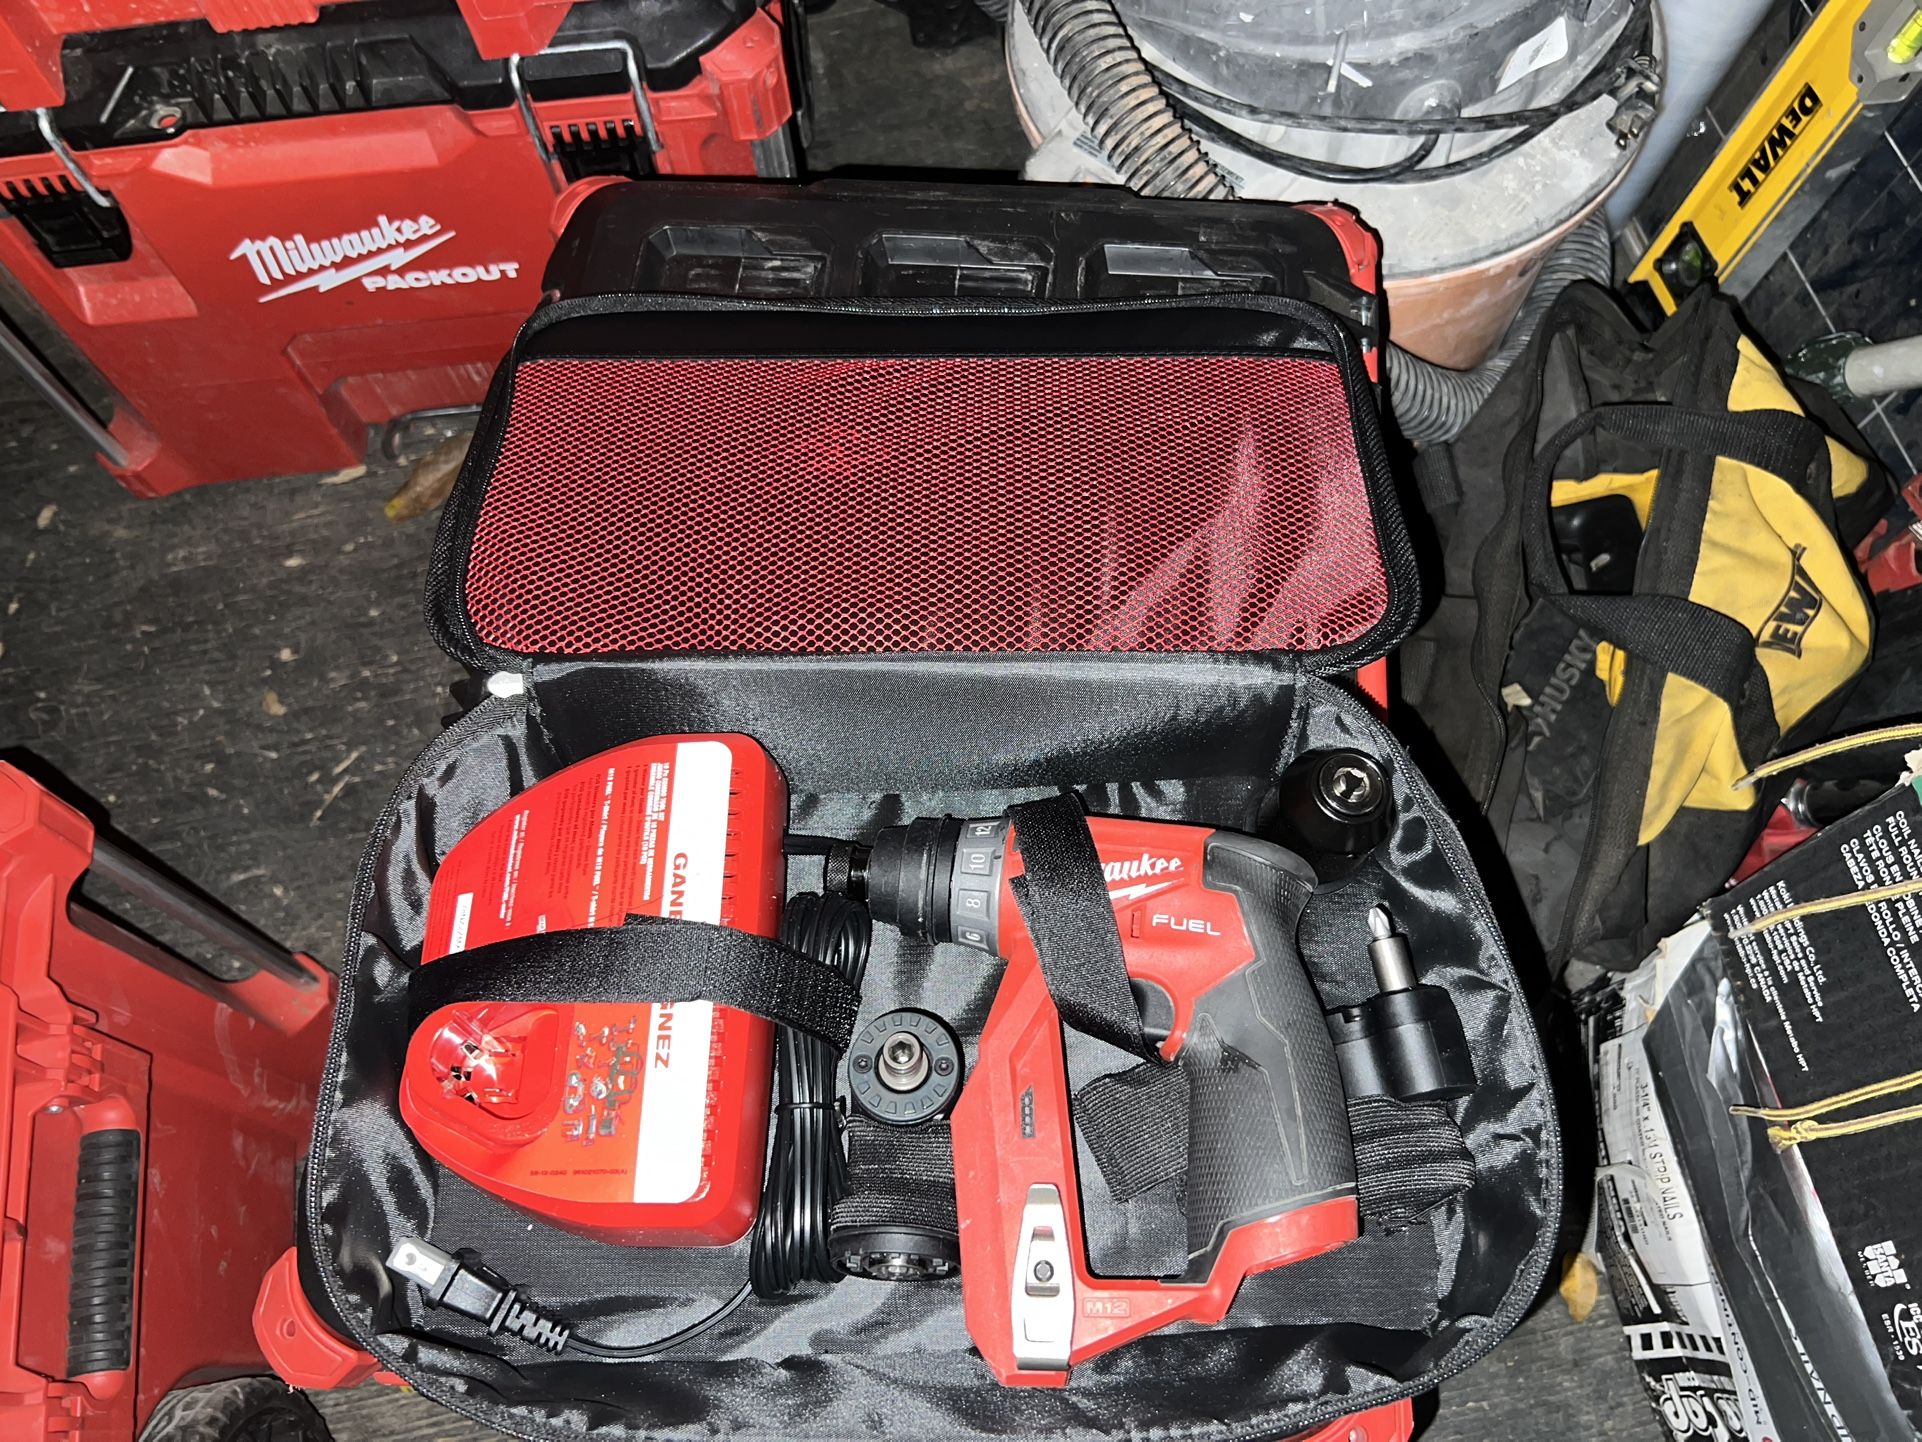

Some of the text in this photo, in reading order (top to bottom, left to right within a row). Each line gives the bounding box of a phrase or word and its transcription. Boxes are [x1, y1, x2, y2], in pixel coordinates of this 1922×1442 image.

[1731, 82, 1823, 210] DEWALT
[229, 214, 442, 285] Milwaukee
[361, 261, 520, 292] PACKOUT
[1533, 628, 1598, 723] HUSKY
[975, 825, 992, 836] 12
[1893, 809, 1914, 839] COIL
[969, 853, 985, 872] 10
[1884, 815, 1919, 880] FULL ROUN
[1775, 880, 1792, 904] Koki
[1847, 837, 1875, 883] CLAVOS
[1876, 900, 1902, 942] ROLLO
[1861, 828, 1919, 944] TÊTE RONE PLEINE
[1870, 823, 1922, 928] CLOUS EN OBINE
[966, 898, 980, 908] 8
[965, 931, 981, 941] 6
[1152, 913, 1221, 936] FUEL
[1775, 922, 1796, 960] servicios
[1838, 842, 1866, 889] CABEZA
[1885, 945, 1921, 1013] COMPLETA
[1780, 952, 1793, 972] USA
[1788, 934, 1803, 959] Sales
[1799, 958, 1811, 976] and
[1805, 975, 1823, 1007] Service
[1791, 959, 1800, 972] de
[1752, 965, 1772, 1002] CANADA
[1795, 971, 1814, 1004] Metabo
[1750, 940, 1766, 969] service
[1765, 976, 1773, 986] la
[1781, 1020, 1801, 1053] Metabo
[1795, 1053, 1808, 1072] HPT
[1809, 1003, 1822, 1024] HPT
[1658, 1186, 1684, 1221] NAILS
[1086, 1300, 1128, 1315] M12
